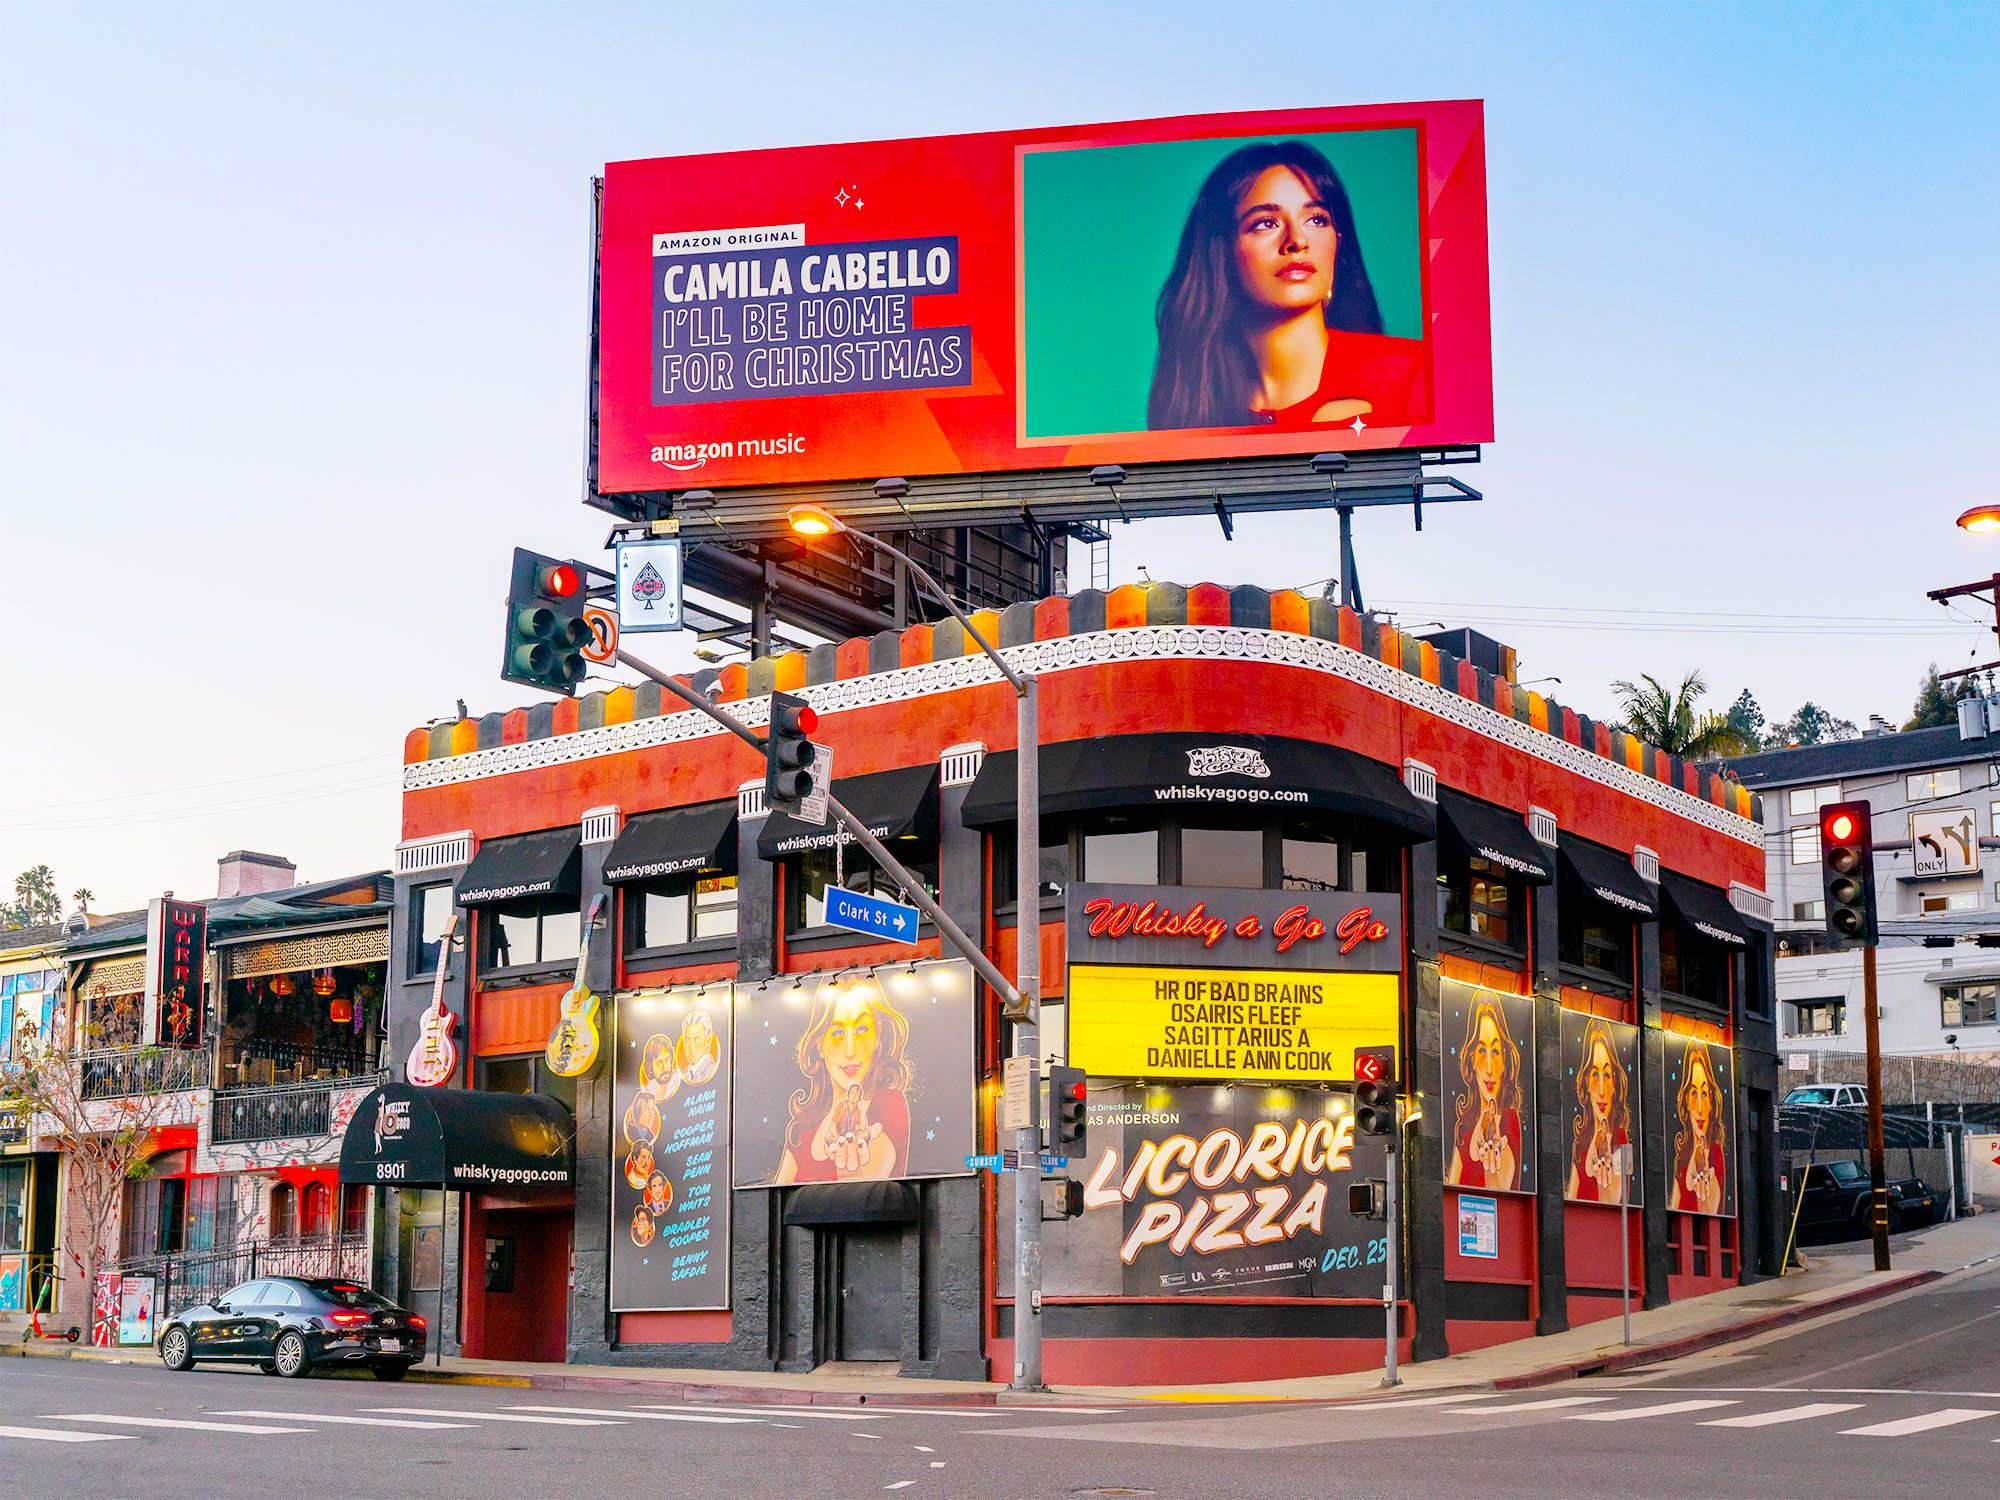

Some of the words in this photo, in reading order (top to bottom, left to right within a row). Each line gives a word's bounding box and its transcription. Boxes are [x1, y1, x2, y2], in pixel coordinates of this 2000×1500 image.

[660, 236, 722, 250] AMAZON
[727, 231, 798, 246] ORIGINAL
[664, 258, 793, 303] CAMILA
[800, 246, 951, 294] CABELLO
[663, 306, 731, 349] I'LL
[743, 302, 788, 342] BE
[799, 295, 906, 338] HOME
[663, 351, 733, 394] FOR
[745, 337, 962, 388] CHRISTMAS
[651, 441, 733, 467] amazon
[737, 432, 806, 455] music
[623, 552, 629, 561] A
[634, 581, 663, 592] ACE
[1155, 784, 1309, 803] whiskyagogo.com
[607, 855, 706, 879] whiskyagogo.com
[1478, 847, 1546, 877] whiskyagogo.com
[1918, 860, 1944, 872] ONLY
[460, 880, 550, 902] whiskyagogo.com
[839, 901, 869, 921] Clark
[874, 910, 887, 926] St
[1084, 898, 1227, 947] Whisky
[1234, 914, 1263, 938] a
[1273, 904, 1326, 952] Go
[1335, 906, 1389, 954] Go
[1155, 980, 1179, 1000] HR
[1184, 981, 1209, 1001] OF
[1210, 982, 1250, 1002] BAD
[1254, 983, 1323, 1005] BRAINS
[1171, 1003, 1244, 1024] OSAIRIS
[1248, 1005, 1302, 1026] FLEEF
[1297, 1028, 1310, 1048] A
[1147, 1047, 1237, 1069] DANIELLE
[1243, 1050, 1281, 1070] ANN
[1285, 1051, 1332, 1072] COOK
[683, 1089, 716, 1108] ALANA
[1097, 1103, 1130, 1111] Directed
[1132, 1103, 1142, 1111] by
[688, 1101, 716, 1118] HAIM
[1107, 1114, 1180, 1125] ANDERSON
[673, 1118, 715, 1140] COOPER
[664, 1131, 714, 1155] HOFFMAN
[686, 1150, 713, 1167] SEAN
[969, 1156, 998, 1167] SUNSET
[1084, 1113, 1355, 1208] LICORICE
[376, 1163, 405, 1179] 8901
[454, 1163, 568, 1183] whiskyagogo.com
[682, 1163, 712, 1181] PENN
[687, 1183, 711, 1198] TOM
[678, 1196, 711, 1213] WAITS
[662, 1216, 710, 1237] BRADLEY
[1120, 1179, 1328, 1265] PIZZA
[669, 1229, 710, 1249] COOPER
[672, 1250, 709, 1268] BENNY
[1298, 1257, 1316, 1272] MGM
[1321, 1245, 1362, 1273] DEC.
[1367, 1237, 1387, 1265] 25
[671, 1263, 708, 1282] SAFDIE
[1265, 1262, 1294, 1272] BRON
